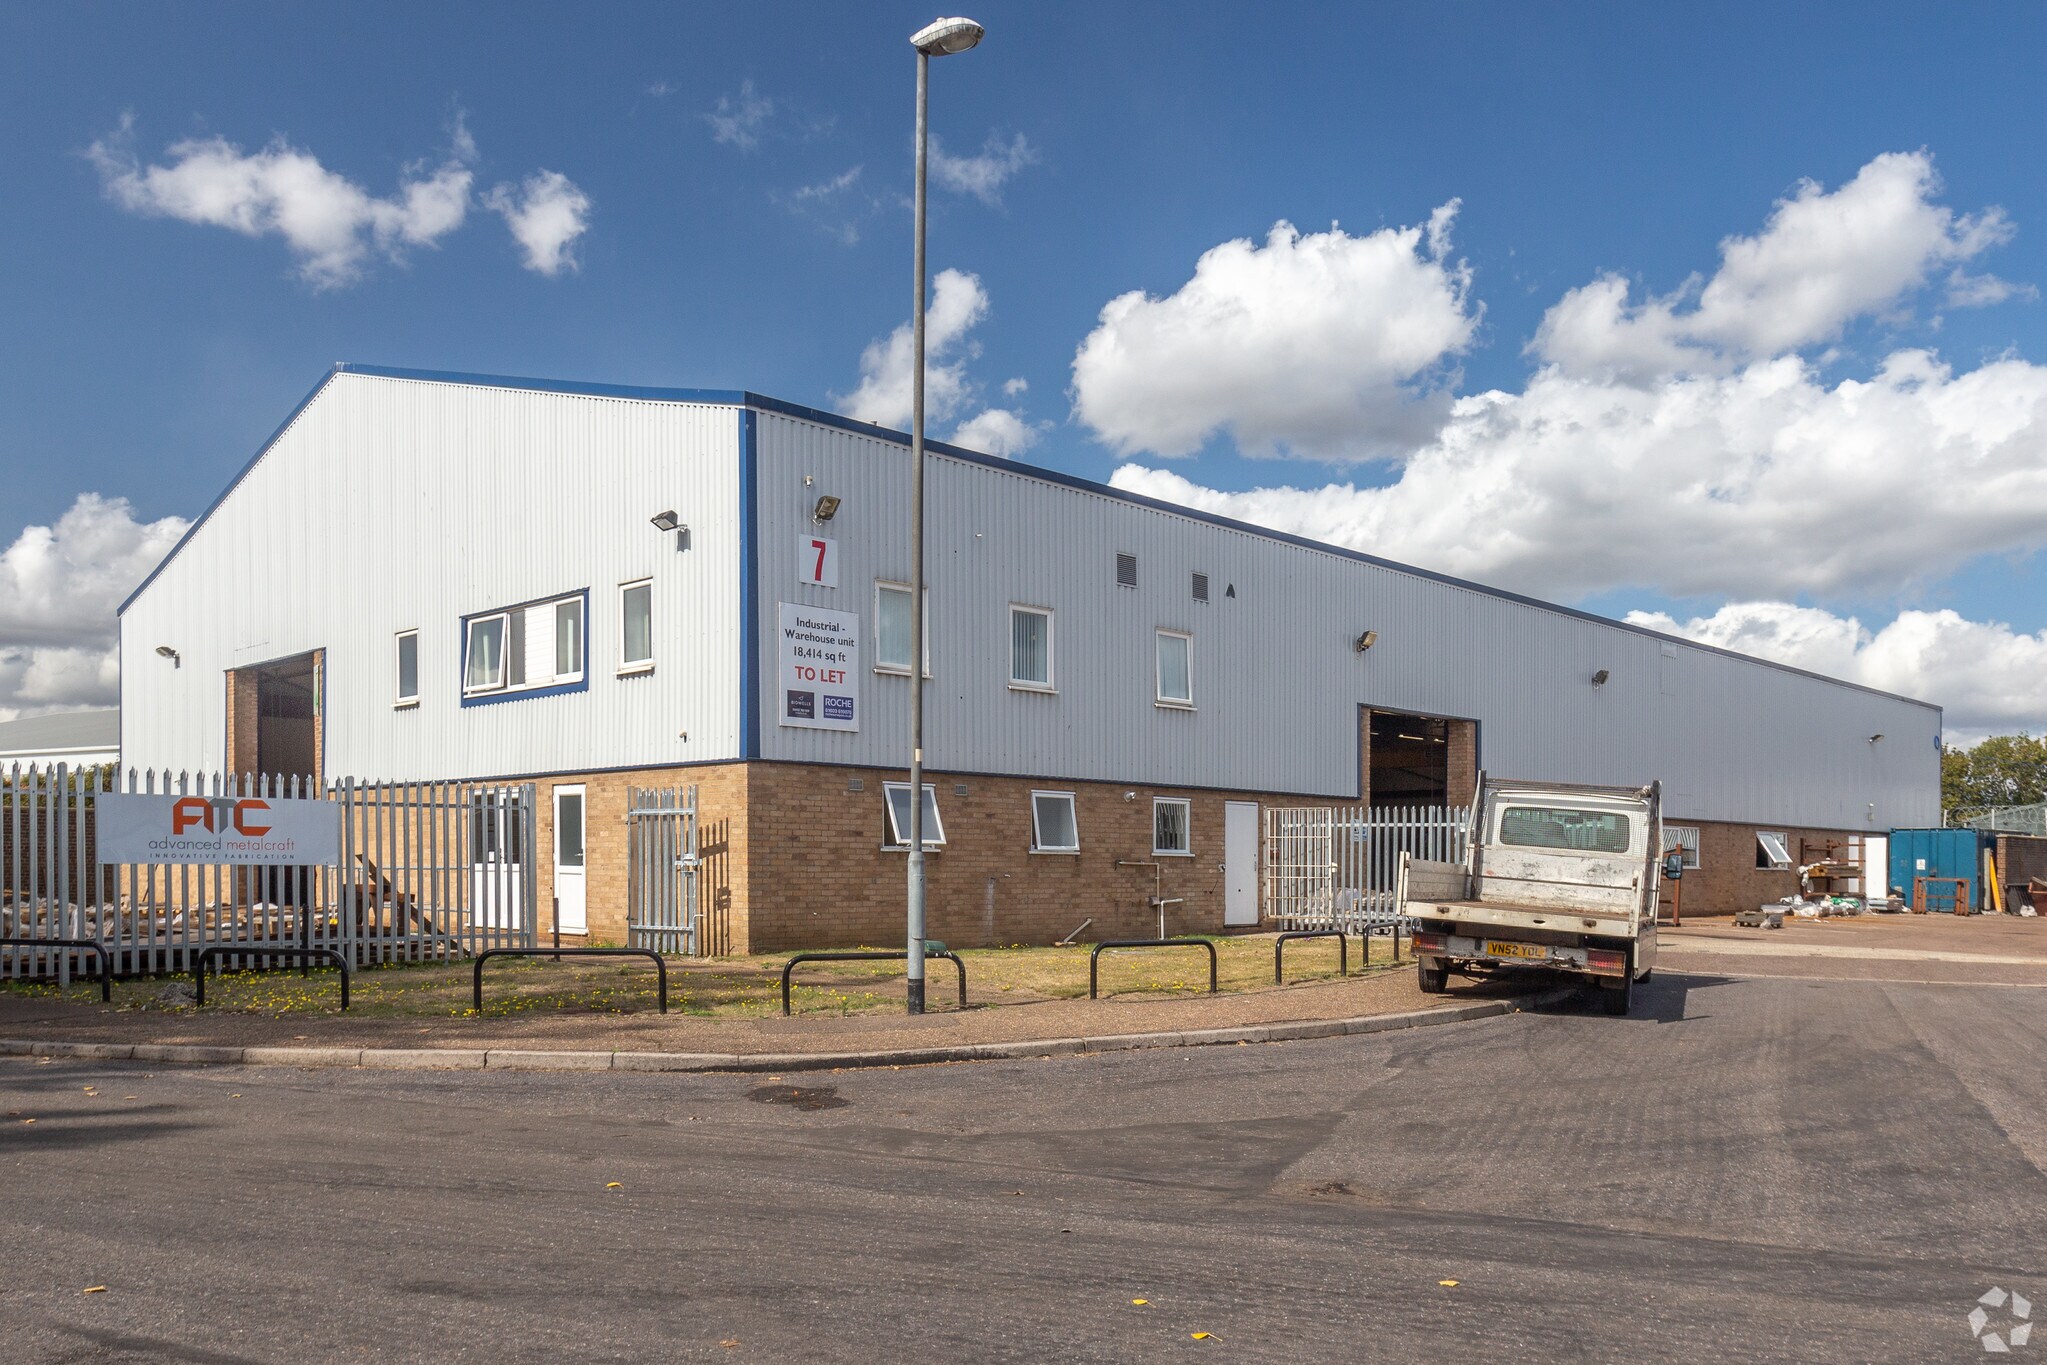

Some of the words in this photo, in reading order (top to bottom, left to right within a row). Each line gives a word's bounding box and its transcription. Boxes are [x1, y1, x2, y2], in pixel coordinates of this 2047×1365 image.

[812, 540, 826, 581] 7
[796, 617, 839, 632] Industrial
[785, 629, 835, 645] Warehouse
[838, 637, 855, 647] unit
[794, 646, 822, 659] 18,414
[825, 653, 836, 663] sq
[838, 652, 846, 662] ft
[795, 666, 816, 681] TO
[820, 669, 846, 684] LET
[825, 698, 852, 708] ROCHE
[148, 836, 222, 850] advanced
[226, 838, 295, 851] metalcraft
[1491, 943, 1519, 955] VN52
